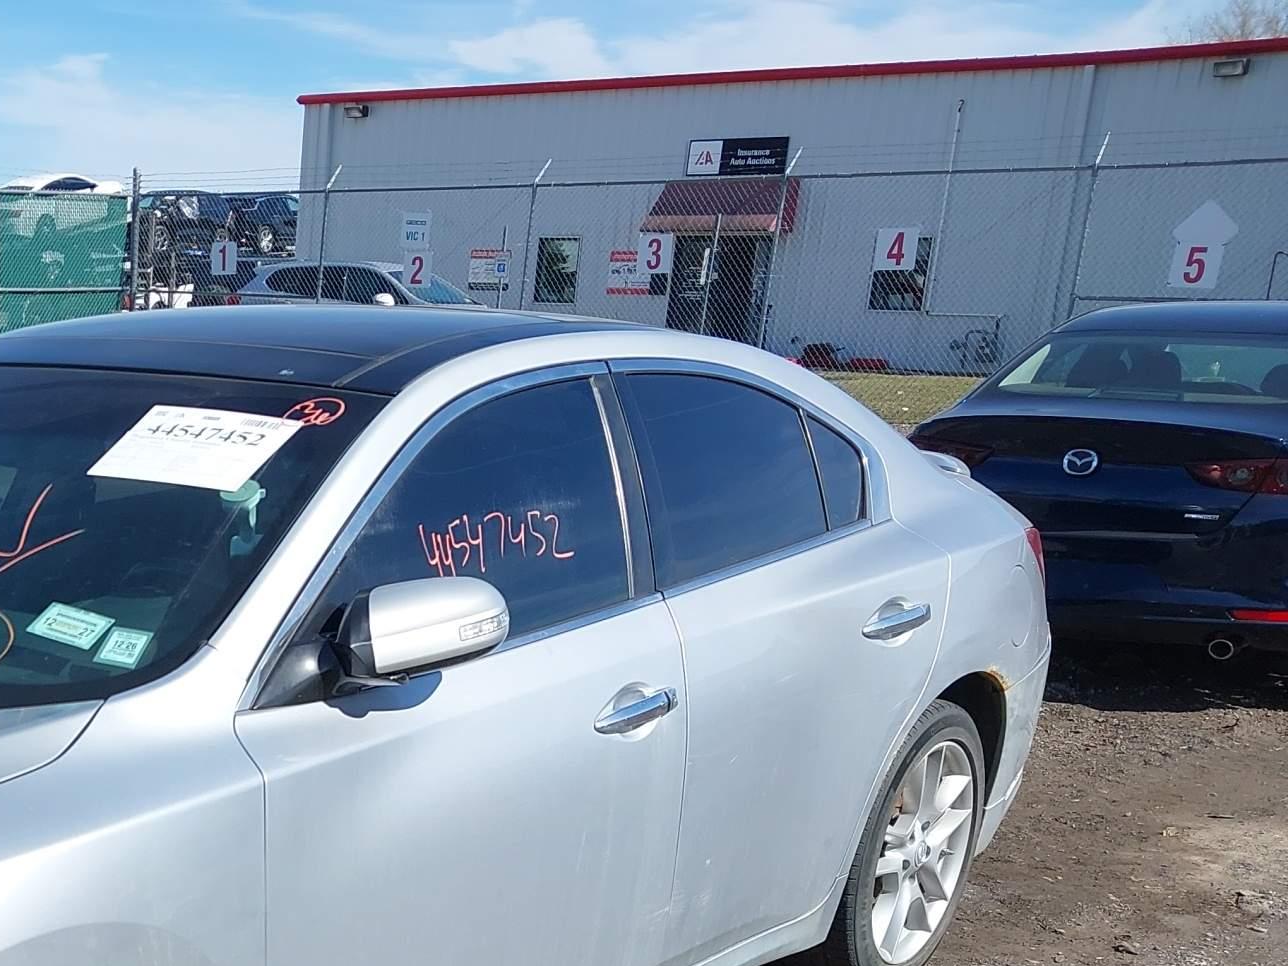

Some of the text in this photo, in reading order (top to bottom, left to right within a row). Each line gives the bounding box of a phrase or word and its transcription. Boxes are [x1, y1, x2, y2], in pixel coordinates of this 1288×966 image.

[730, 157, 776, 166] Auto Auctions
[737, 148, 771, 156] Insurance
[405, 231, 426, 241] VIC 1
[886, 231, 905, 266] 4
[218, 244, 227, 272] 1
[646, 238, 662, 270] 3
[1183, 246, 1209, 284] 5
[410, 255, 424, 285] 2
[147, 423, 267, 447] 44547452
[418, 511, 575, 577] 44547452
[43, 617, 57, 627] 12
[78, 627, 96, 638] 27
